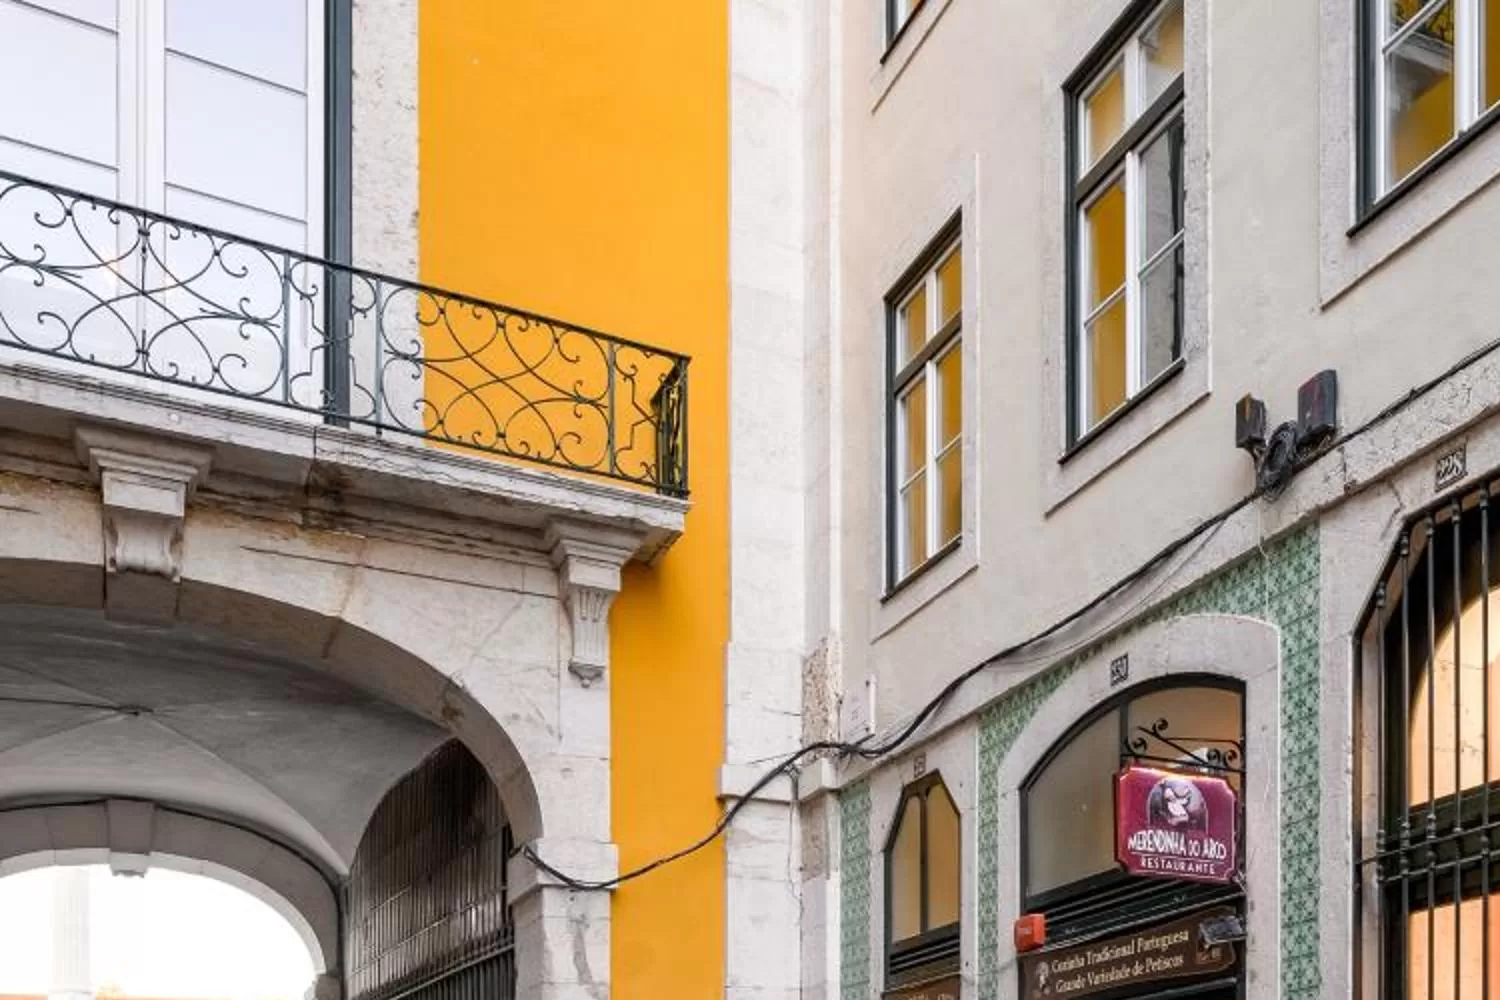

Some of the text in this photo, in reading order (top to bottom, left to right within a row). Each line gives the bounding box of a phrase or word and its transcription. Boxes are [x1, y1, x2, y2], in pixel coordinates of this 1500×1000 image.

[1141, 857, 1215, 875] RESTAURANTE
[1087, 940, 1135, 966] Tradicional
[1138, 931, 1189, 953] Portuguesa
[1132, 961, 1145, 976] de
[1146, 955, 1184, 972] Petiscos
